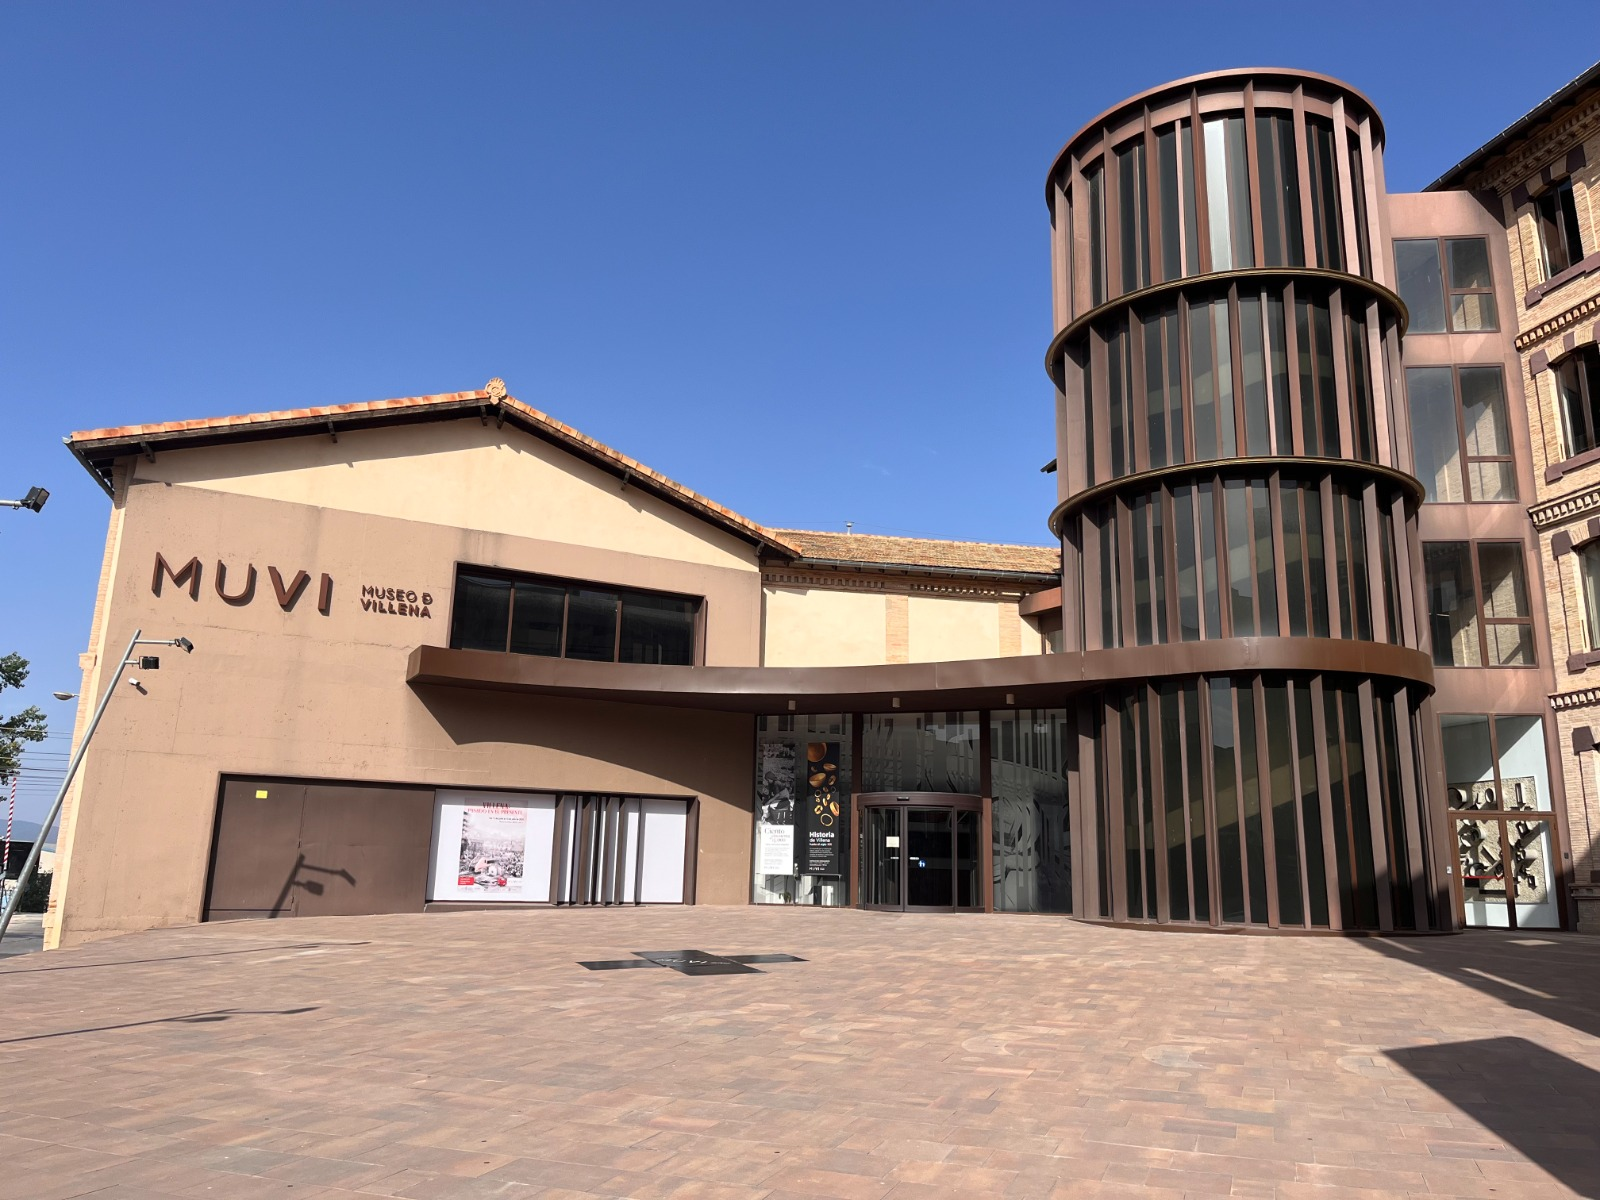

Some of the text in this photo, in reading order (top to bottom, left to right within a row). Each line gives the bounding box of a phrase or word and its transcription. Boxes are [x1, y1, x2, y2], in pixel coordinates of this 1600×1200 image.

[151, 551, 332, 613] MUVI
[361, 584, 418, 604] MUSEO
[360, 597, 432, 619] VILLENA
